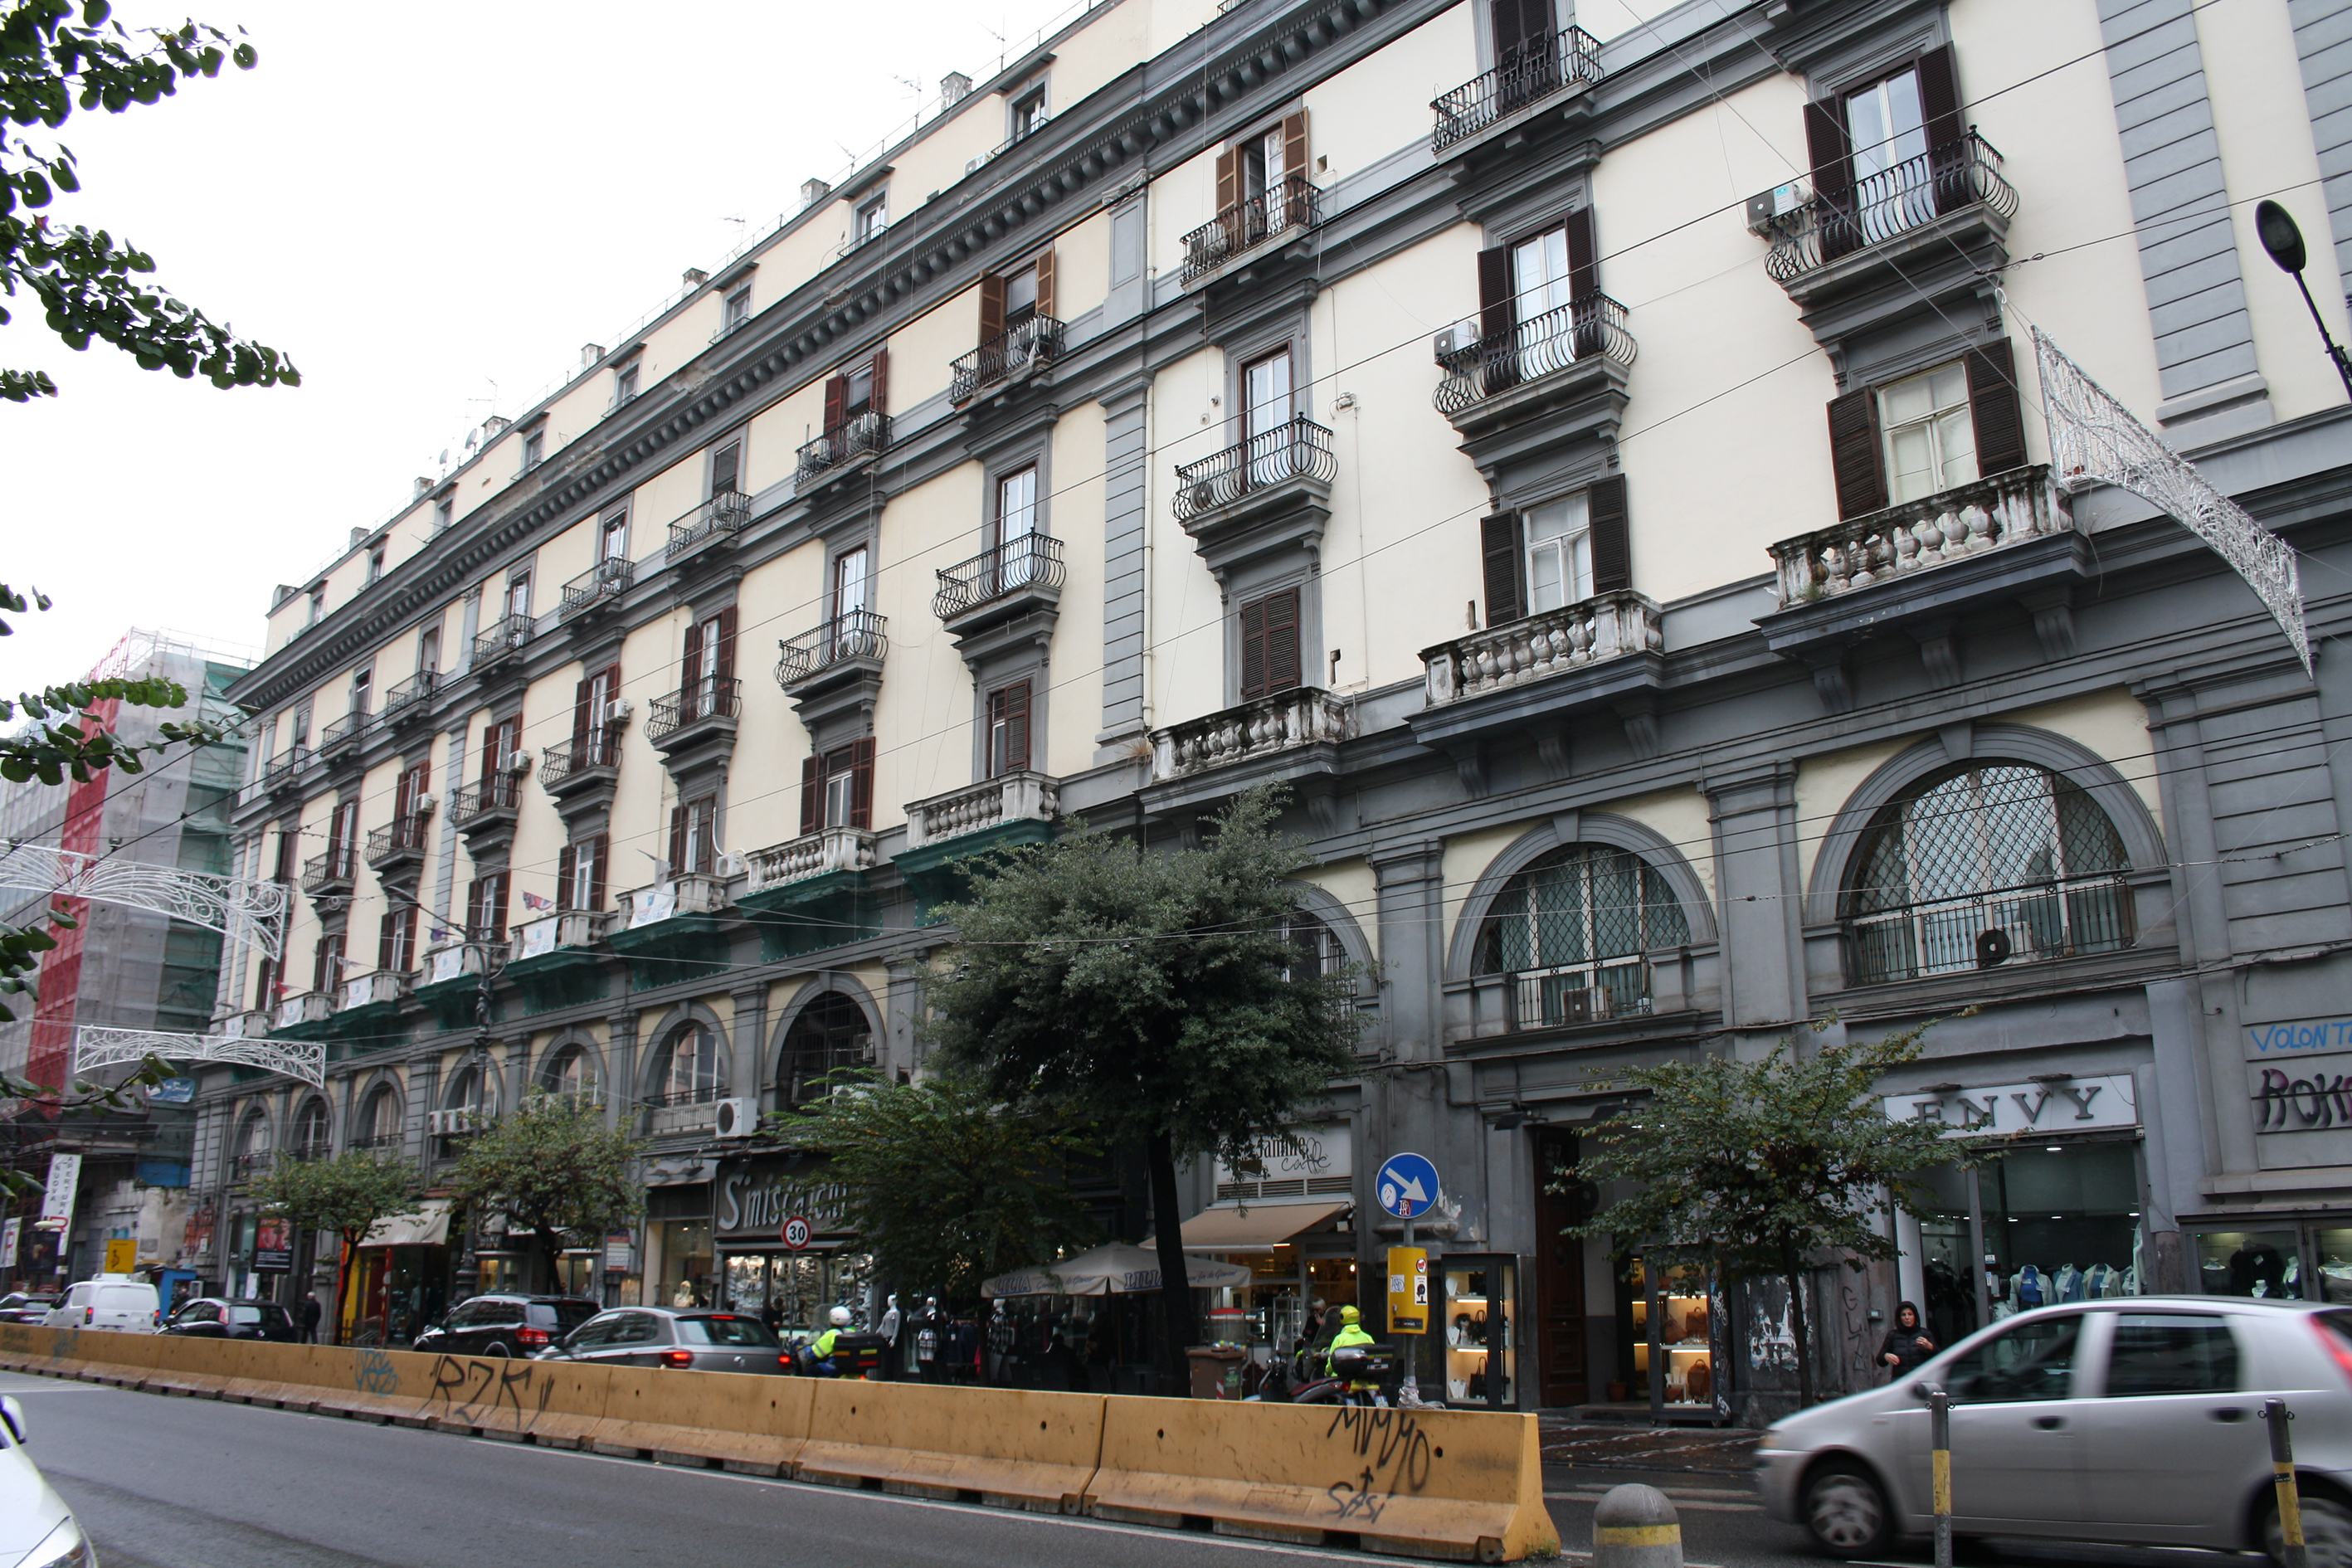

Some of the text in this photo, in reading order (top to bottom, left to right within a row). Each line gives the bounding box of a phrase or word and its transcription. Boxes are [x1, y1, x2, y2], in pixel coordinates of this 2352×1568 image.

[2250, 1021, 2352, 1052] VOLONT
[1912, 1086, 2101, 1127] ENVY
[789, 1225, 806, 1241] 30
[993, 1277, 1032, 1295] LILIA
[1123, 1269, 1163, 1290] LILI
